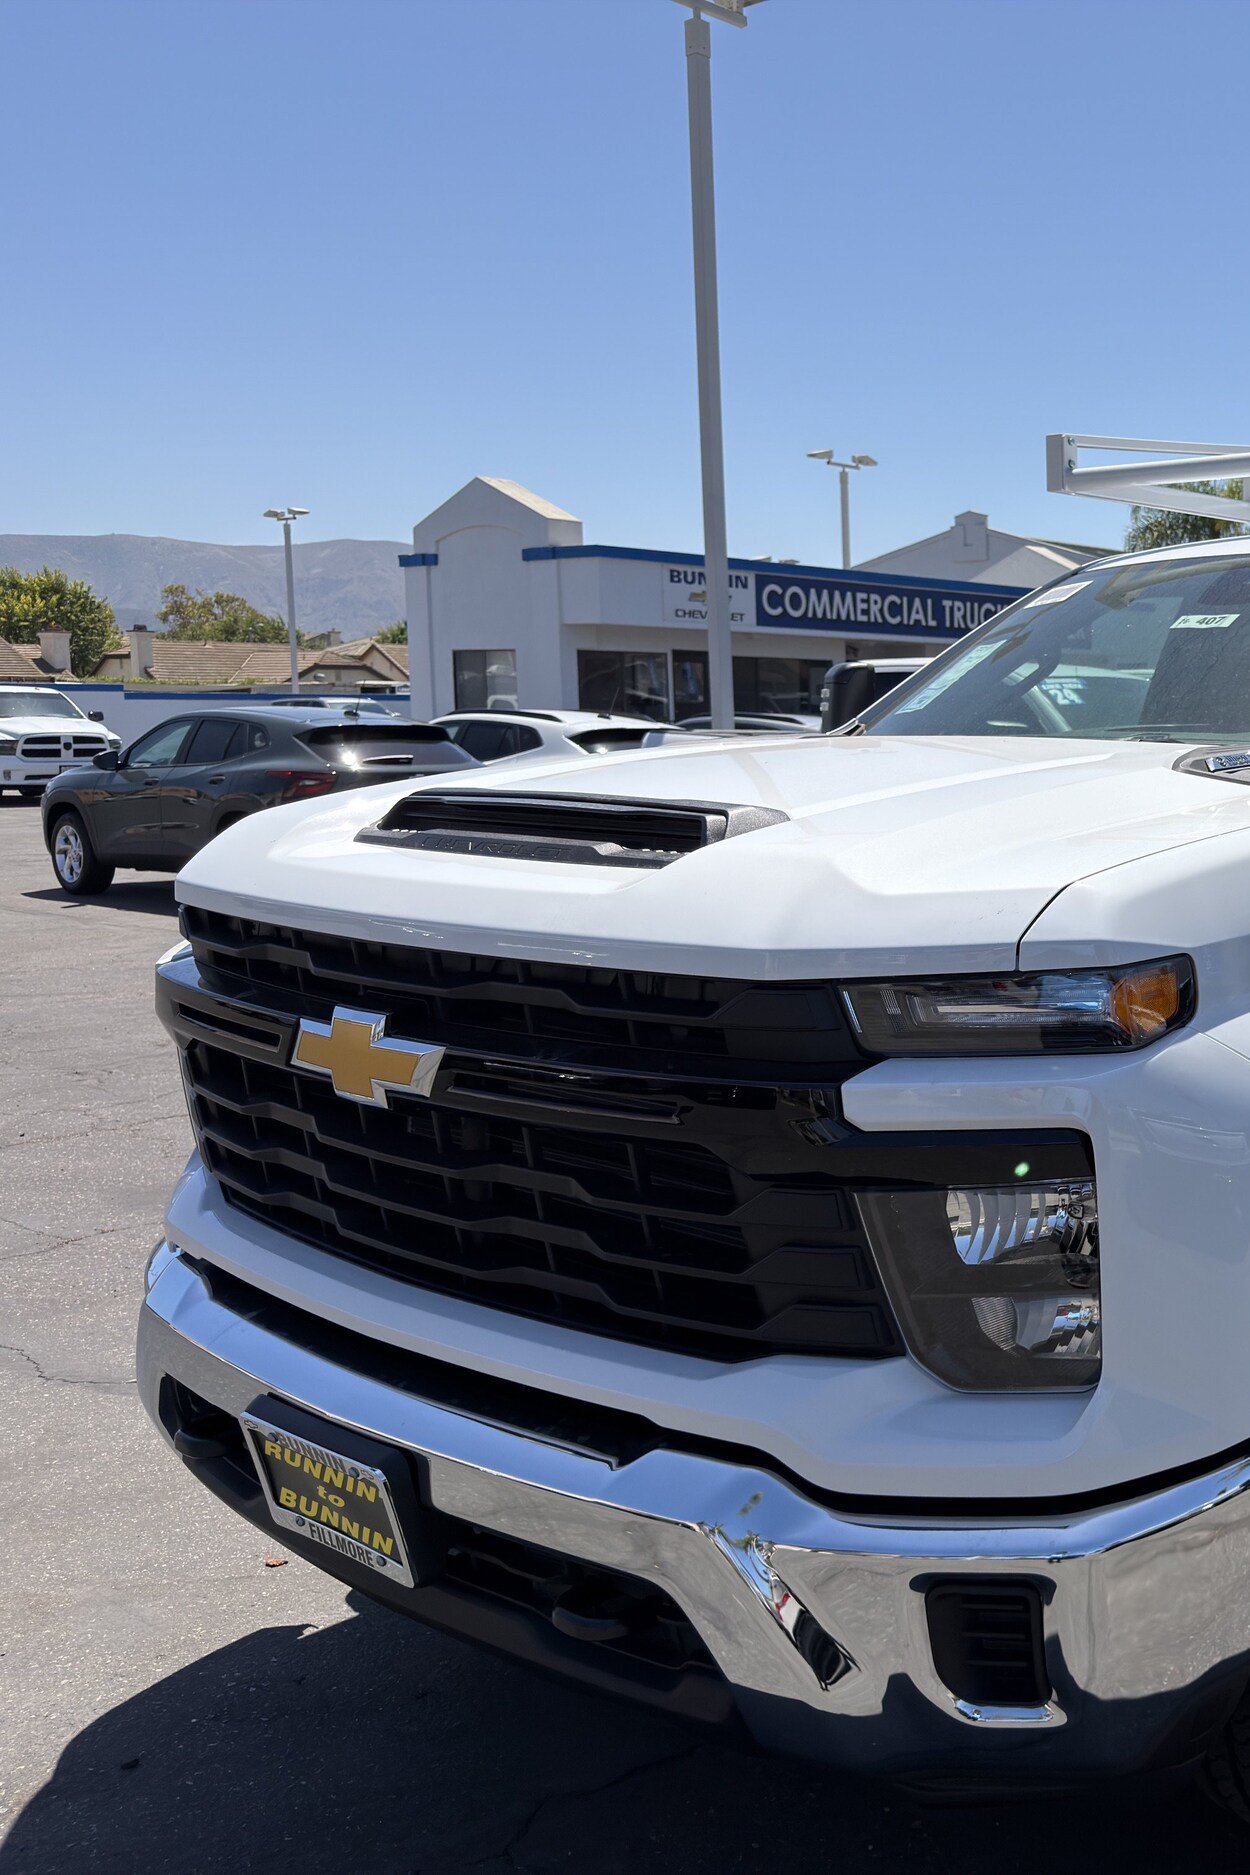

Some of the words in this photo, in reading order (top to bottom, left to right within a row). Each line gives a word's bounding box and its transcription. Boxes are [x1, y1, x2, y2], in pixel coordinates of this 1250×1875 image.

[669, 569, 748, 589] BUNIN
[674, 608, 746, 622] CHEVET
[761, 583, 937, 628] COMMERCIAL
[942, 599, 1008, 630] TRUC
[317, 1485, 346, 1508] to
[279, 1486, 394, 1556] BUNNIN
[309, 1522, 375, 1569] FILLMORE
